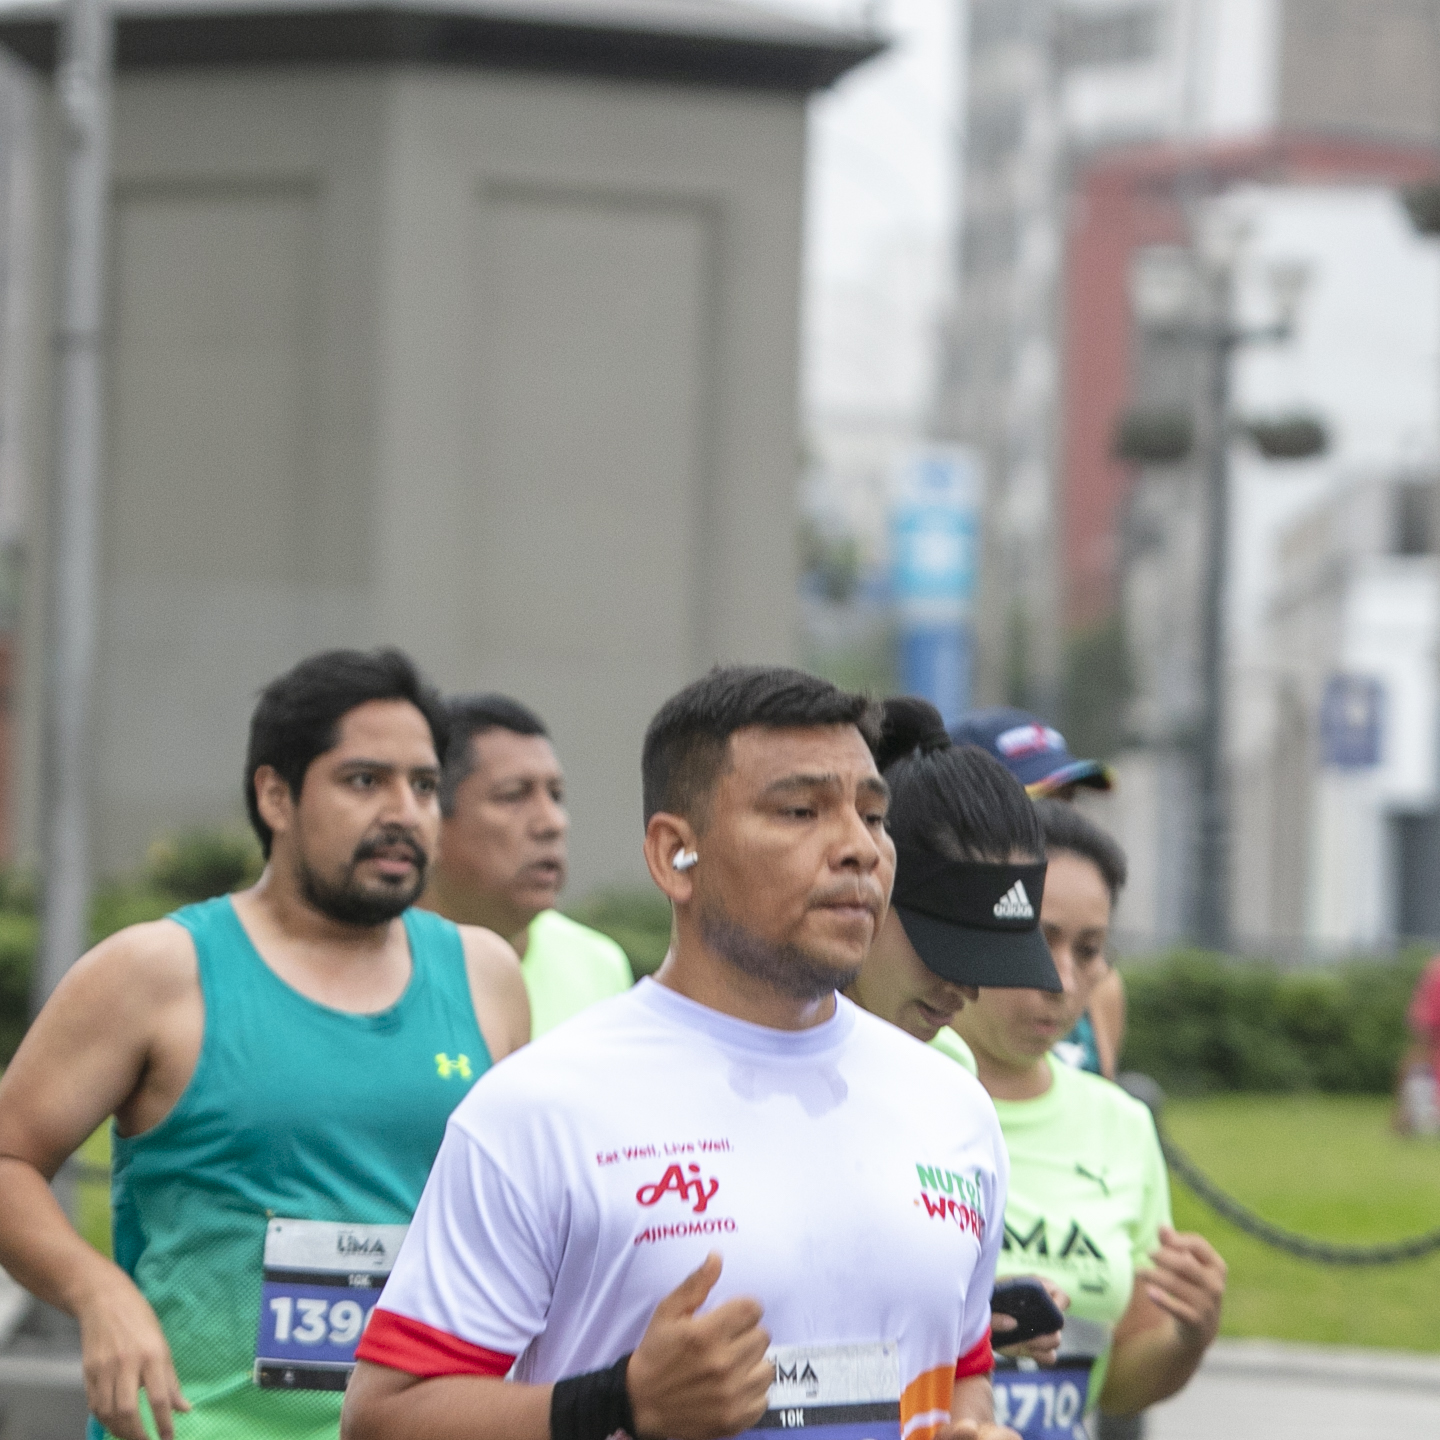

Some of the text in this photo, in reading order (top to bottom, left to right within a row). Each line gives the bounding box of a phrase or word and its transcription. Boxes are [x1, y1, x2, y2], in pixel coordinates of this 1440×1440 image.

[993, 902, 1034, 918] adidas
[596, 1151, 618, 1166] Eat
[664, 1142, 694, 1156] Live
[336, 1233, 387, 1255] LIMA
[779, 1408, 804, 1427] 10K
